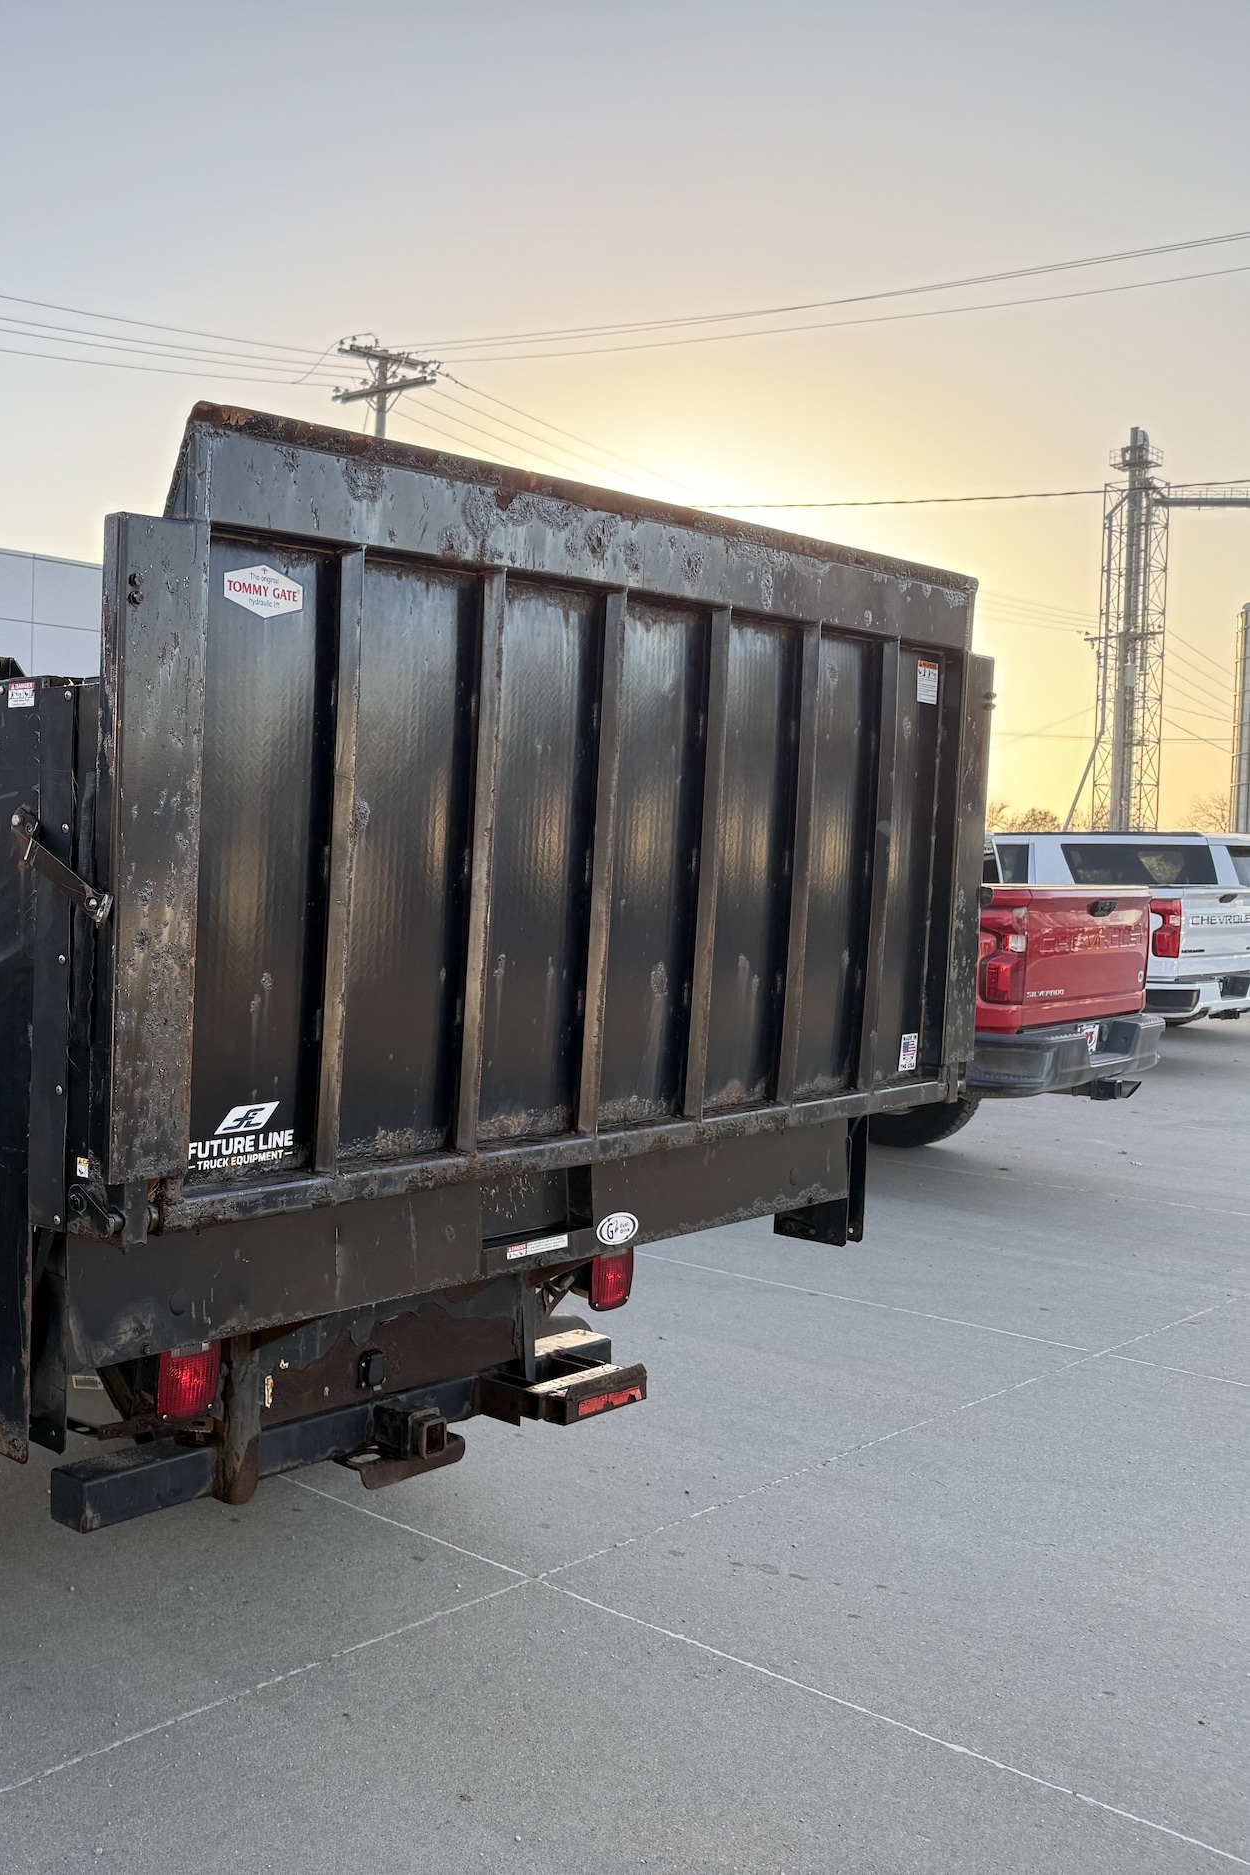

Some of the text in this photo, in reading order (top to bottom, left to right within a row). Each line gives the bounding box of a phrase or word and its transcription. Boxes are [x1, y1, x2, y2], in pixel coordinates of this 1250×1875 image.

[227, 579, 298, 603] TOMMY GATE
[250, 572, 280, 585] The original
[1040, 926, 1143, 953] CHEVROLET
[188, 1129, 294, 1160] FUTURE LINE
